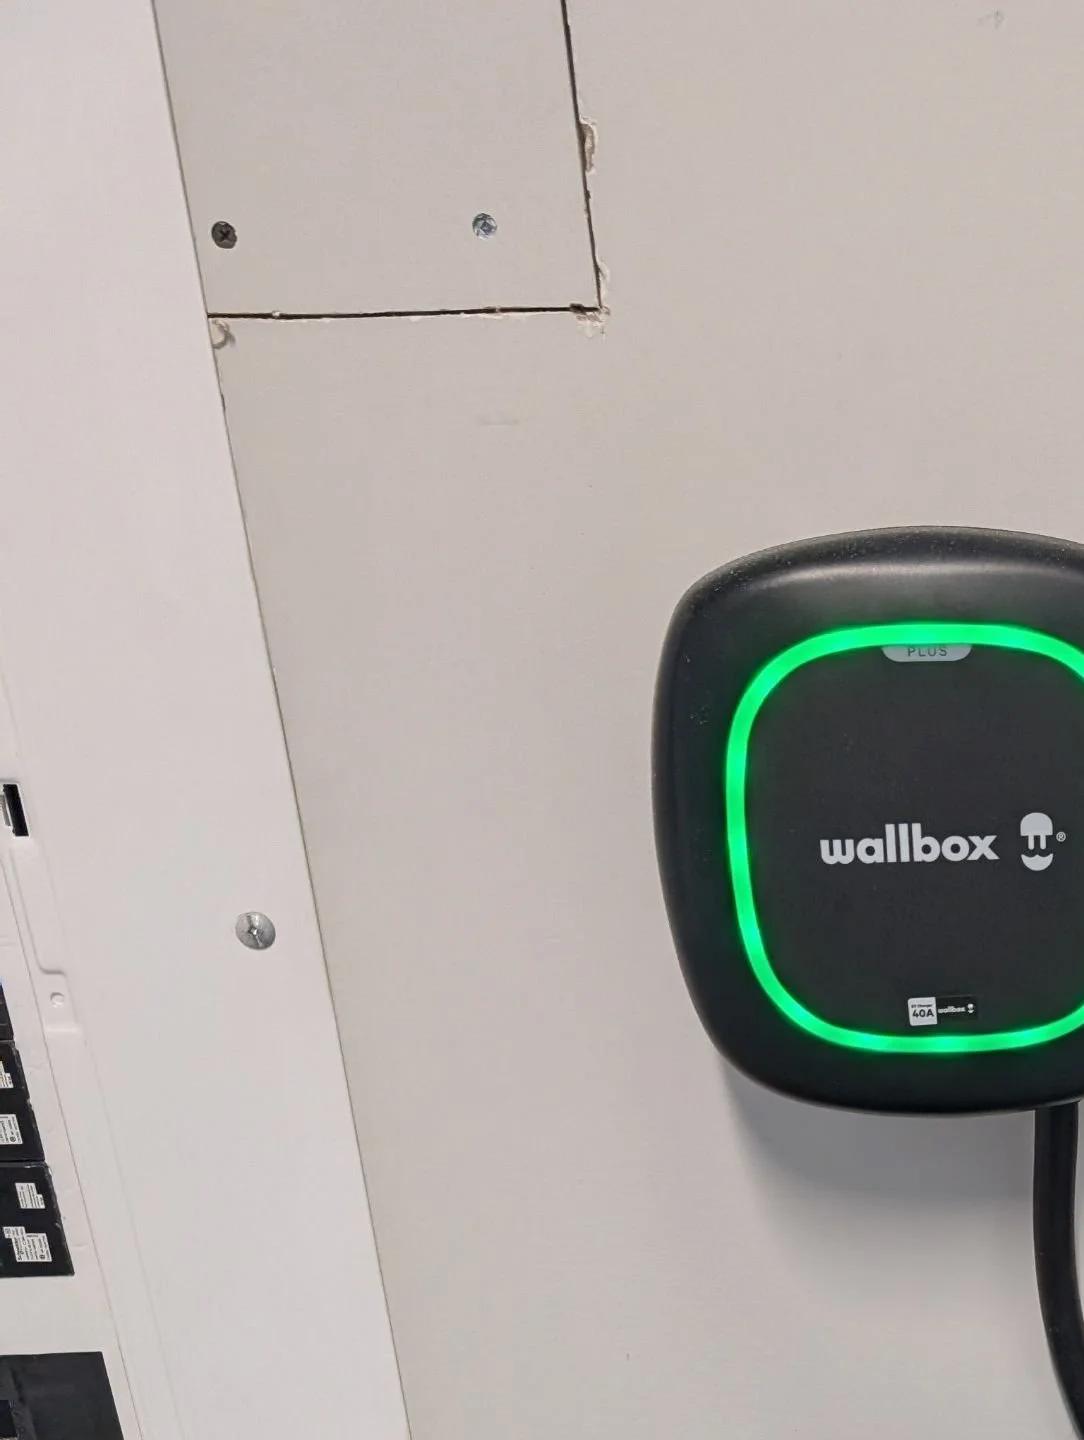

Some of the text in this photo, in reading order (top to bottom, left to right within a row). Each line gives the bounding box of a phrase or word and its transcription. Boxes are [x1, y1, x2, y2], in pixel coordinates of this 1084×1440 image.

[907, 646, 948, 657] PLUS
[819, 822, 999, 864] wallbox
[912, 1009, 935, 1018] 40A
